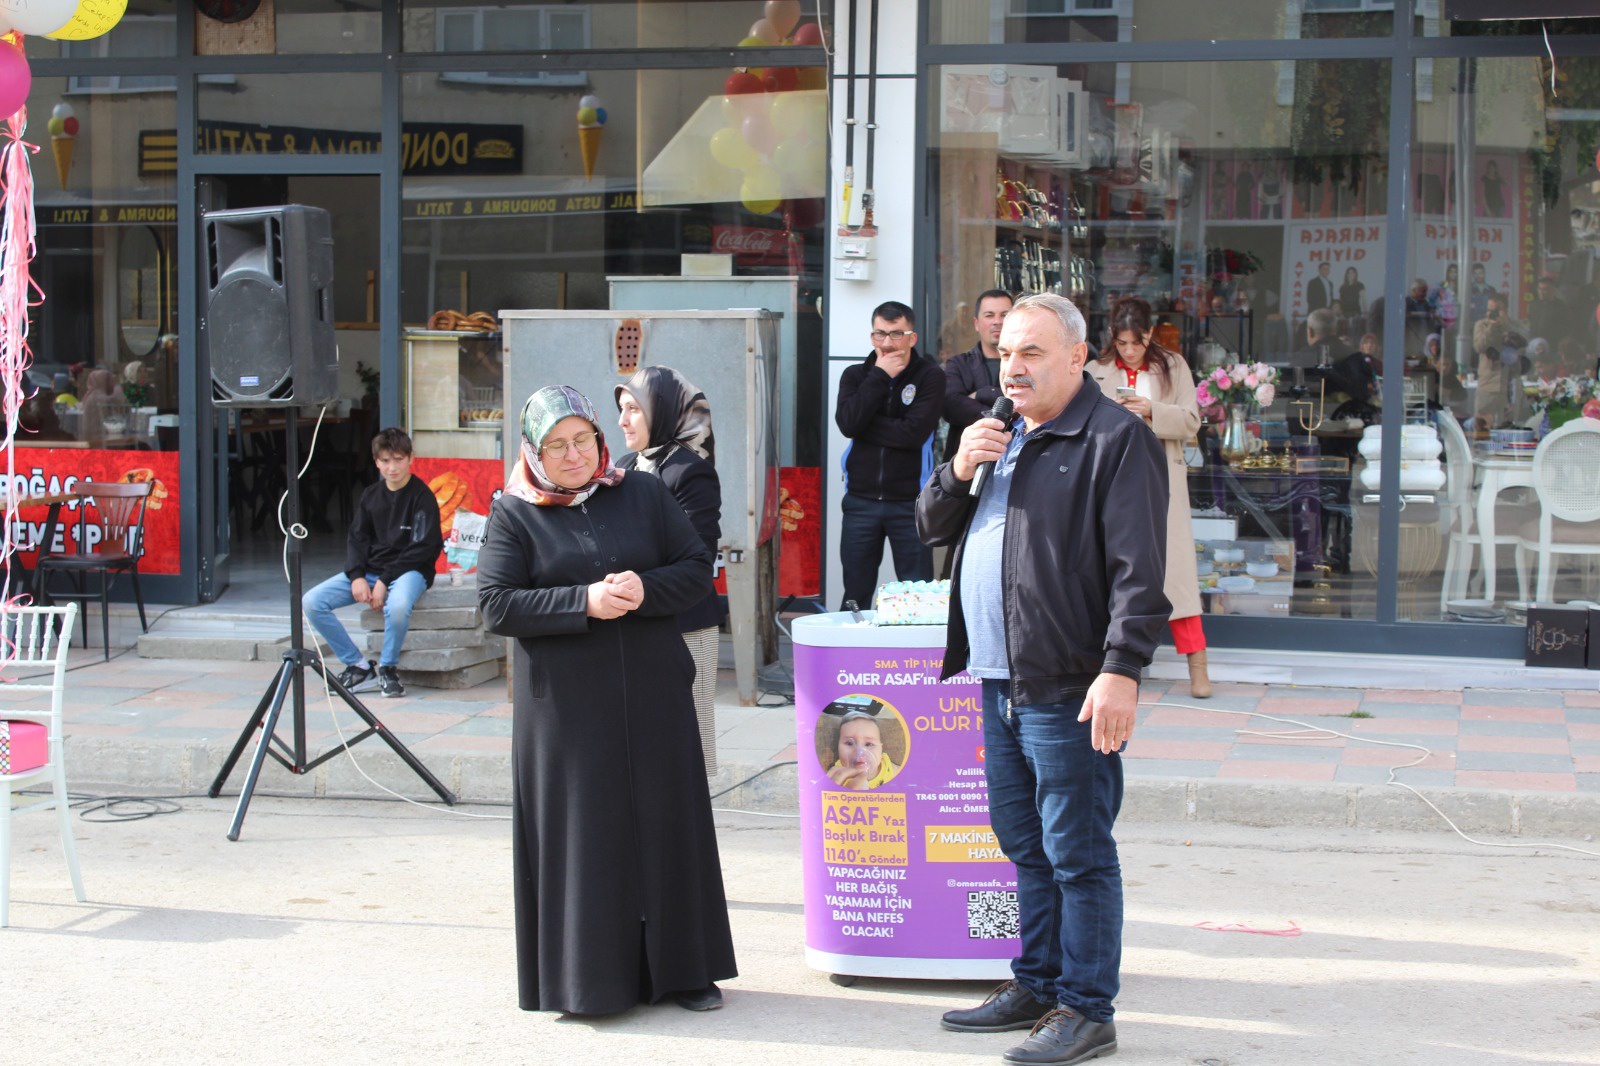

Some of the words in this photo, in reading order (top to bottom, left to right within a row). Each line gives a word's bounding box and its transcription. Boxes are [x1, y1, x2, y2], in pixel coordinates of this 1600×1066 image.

[0, 521, 66, 553] EME
[874, 660, 898, 669] SMA
[903, 658, 920, 669] TİP
[837, 669, 881, 685] ÖMER
[884, 673, 937, 686] ASAF'ın
[913, 716, 971, 731] OLUR
[956, 768, 985, 776] Valilik
[948, 781, 977, 790] Hesap
[823, 793, 839, 801] Tüm
[840, 794, 905, 803] Operatörlerden
[915, 793, 937, 801] TR45
[939, 805, 962, 813] Alıcı:
[963, 803, 990, 813] ÖMER
[825, 805, 879, 826] ASAF
[883, 816, 905, 826] Yaz
[824, 828, 865, 844] Boşluk
[869, 830, 906, 843] Bırak
[929, 832, 938, 843] 7
[941, 830, 995, 844] MAKİNE
[869, 854, 907, 864] Gönder
[827, 866, 907, 880] YAPACAĞINIZ
[836, 882, 859, 893] HER
[861, 881, 898, 897] BAĞIŞ
[824, 894, 882, 910] YAŞAMAM
[884, 896, 912, 912] İÇİN
[832, 910, 865, 922] BANA
[867, 912, 905, 923] NEFES
[841, 925, 894, 938] OLACAK!
